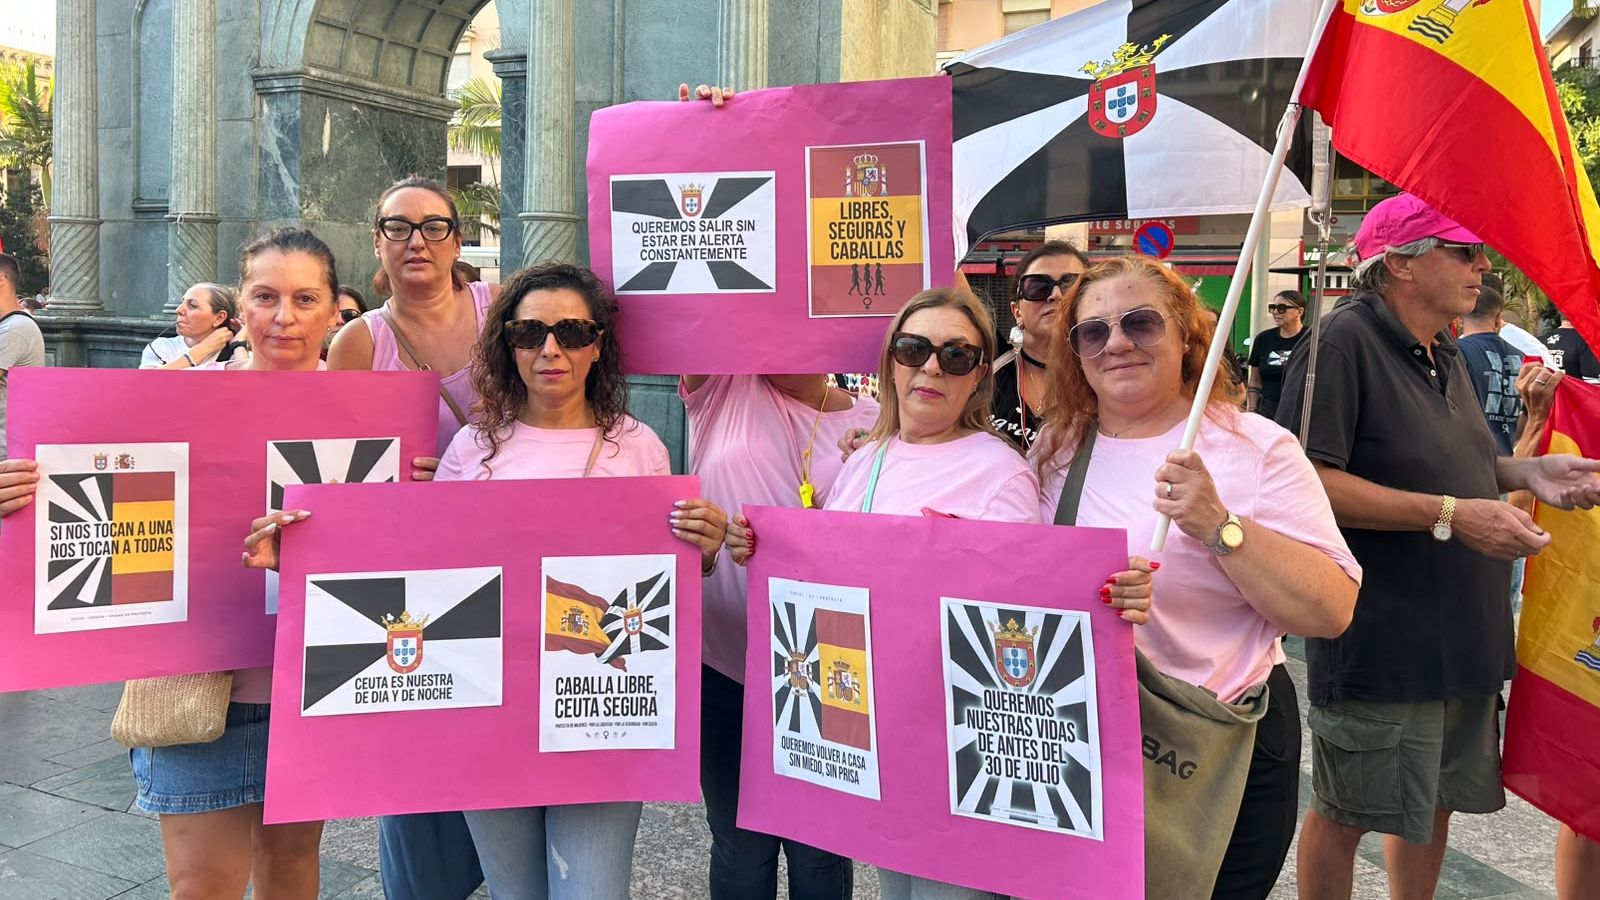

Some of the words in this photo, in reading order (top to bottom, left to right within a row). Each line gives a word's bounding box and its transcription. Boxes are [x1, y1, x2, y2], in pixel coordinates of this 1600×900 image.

[840, 201, 893, 220] LIBRES,
[632, 220, 696, 234] QUEREMOS
[699, 220, 733, 232] SALIR
[736, 219, 755, 232] SIN
[829, 221, 893, 240] SEGURAS
[897, 220, 906, 239] Y
[642, 235, 678, 247] ESTAR
[681, 234, 696, 246] EN
[699, 234, 744, 246] ALERTA
[831, 240, 904, 260] CABALLAS
[640, 247, 747, 261] CONSTANTEMENTE
[50, 525, 62, 541] SI
[66, 523, 91, 540] NOS
[94, 521, 134, 538] TOCAN
[137, 520, 146, 536] A
[149, 519, 173, 535] UNA
[50, 542, 76, 558] NOS
[79, 540, 119, 557] TOCAN
[123, 539, 131, 554] A
[134, 537, 173, 553] TODAS
[355, 676, 389, 690] CEUTA
[391, 675, 404, 688] ES
[406, 673, 454, 687] NUESTRA
[555, 676, 614, 696] CABALLA
[617, 675, 657, 696] LIBRE,
[355, 691, 369, 704] DE
[371, 690, 389, 703] DIA
[392, 689, 399, 702] Y
[401, 688, 415, 702] DE
[417, 687, 453, 701] NOCHE
[984, 689, 1055, 718] QUEREMOS
[555, 697, 600, 719] CEUTA
[603, 696, 658, 717] SEGURA
[967, 708, 1033, 737] NUESTRAS
[1036, 717, 1076, 743] VIDAS
[781, 735, 816, 757] QUEREMOS
[816, 744, 841, 764] VOLVER
[842, 751, 847, 766] A
[848, 752, 866, 771] CASA
[978, 732, 994, 754] DE
[997, 734, 1039, 760] ANTES
[1042, 740, 1067, 764] DEL
[1142, 734, 1197, 780] BAG
[789, 752, 801, 768] SIN
[802, 756, 824, 777] MIEDO,
[825, 762, 837, 779] SIN
[838, 766, 860, 785] PRISA
[985, 755, 1001, 777] 30
[1005, 757, 1022, 780] DE
[1025, 760, 1060, 786] JULIO
